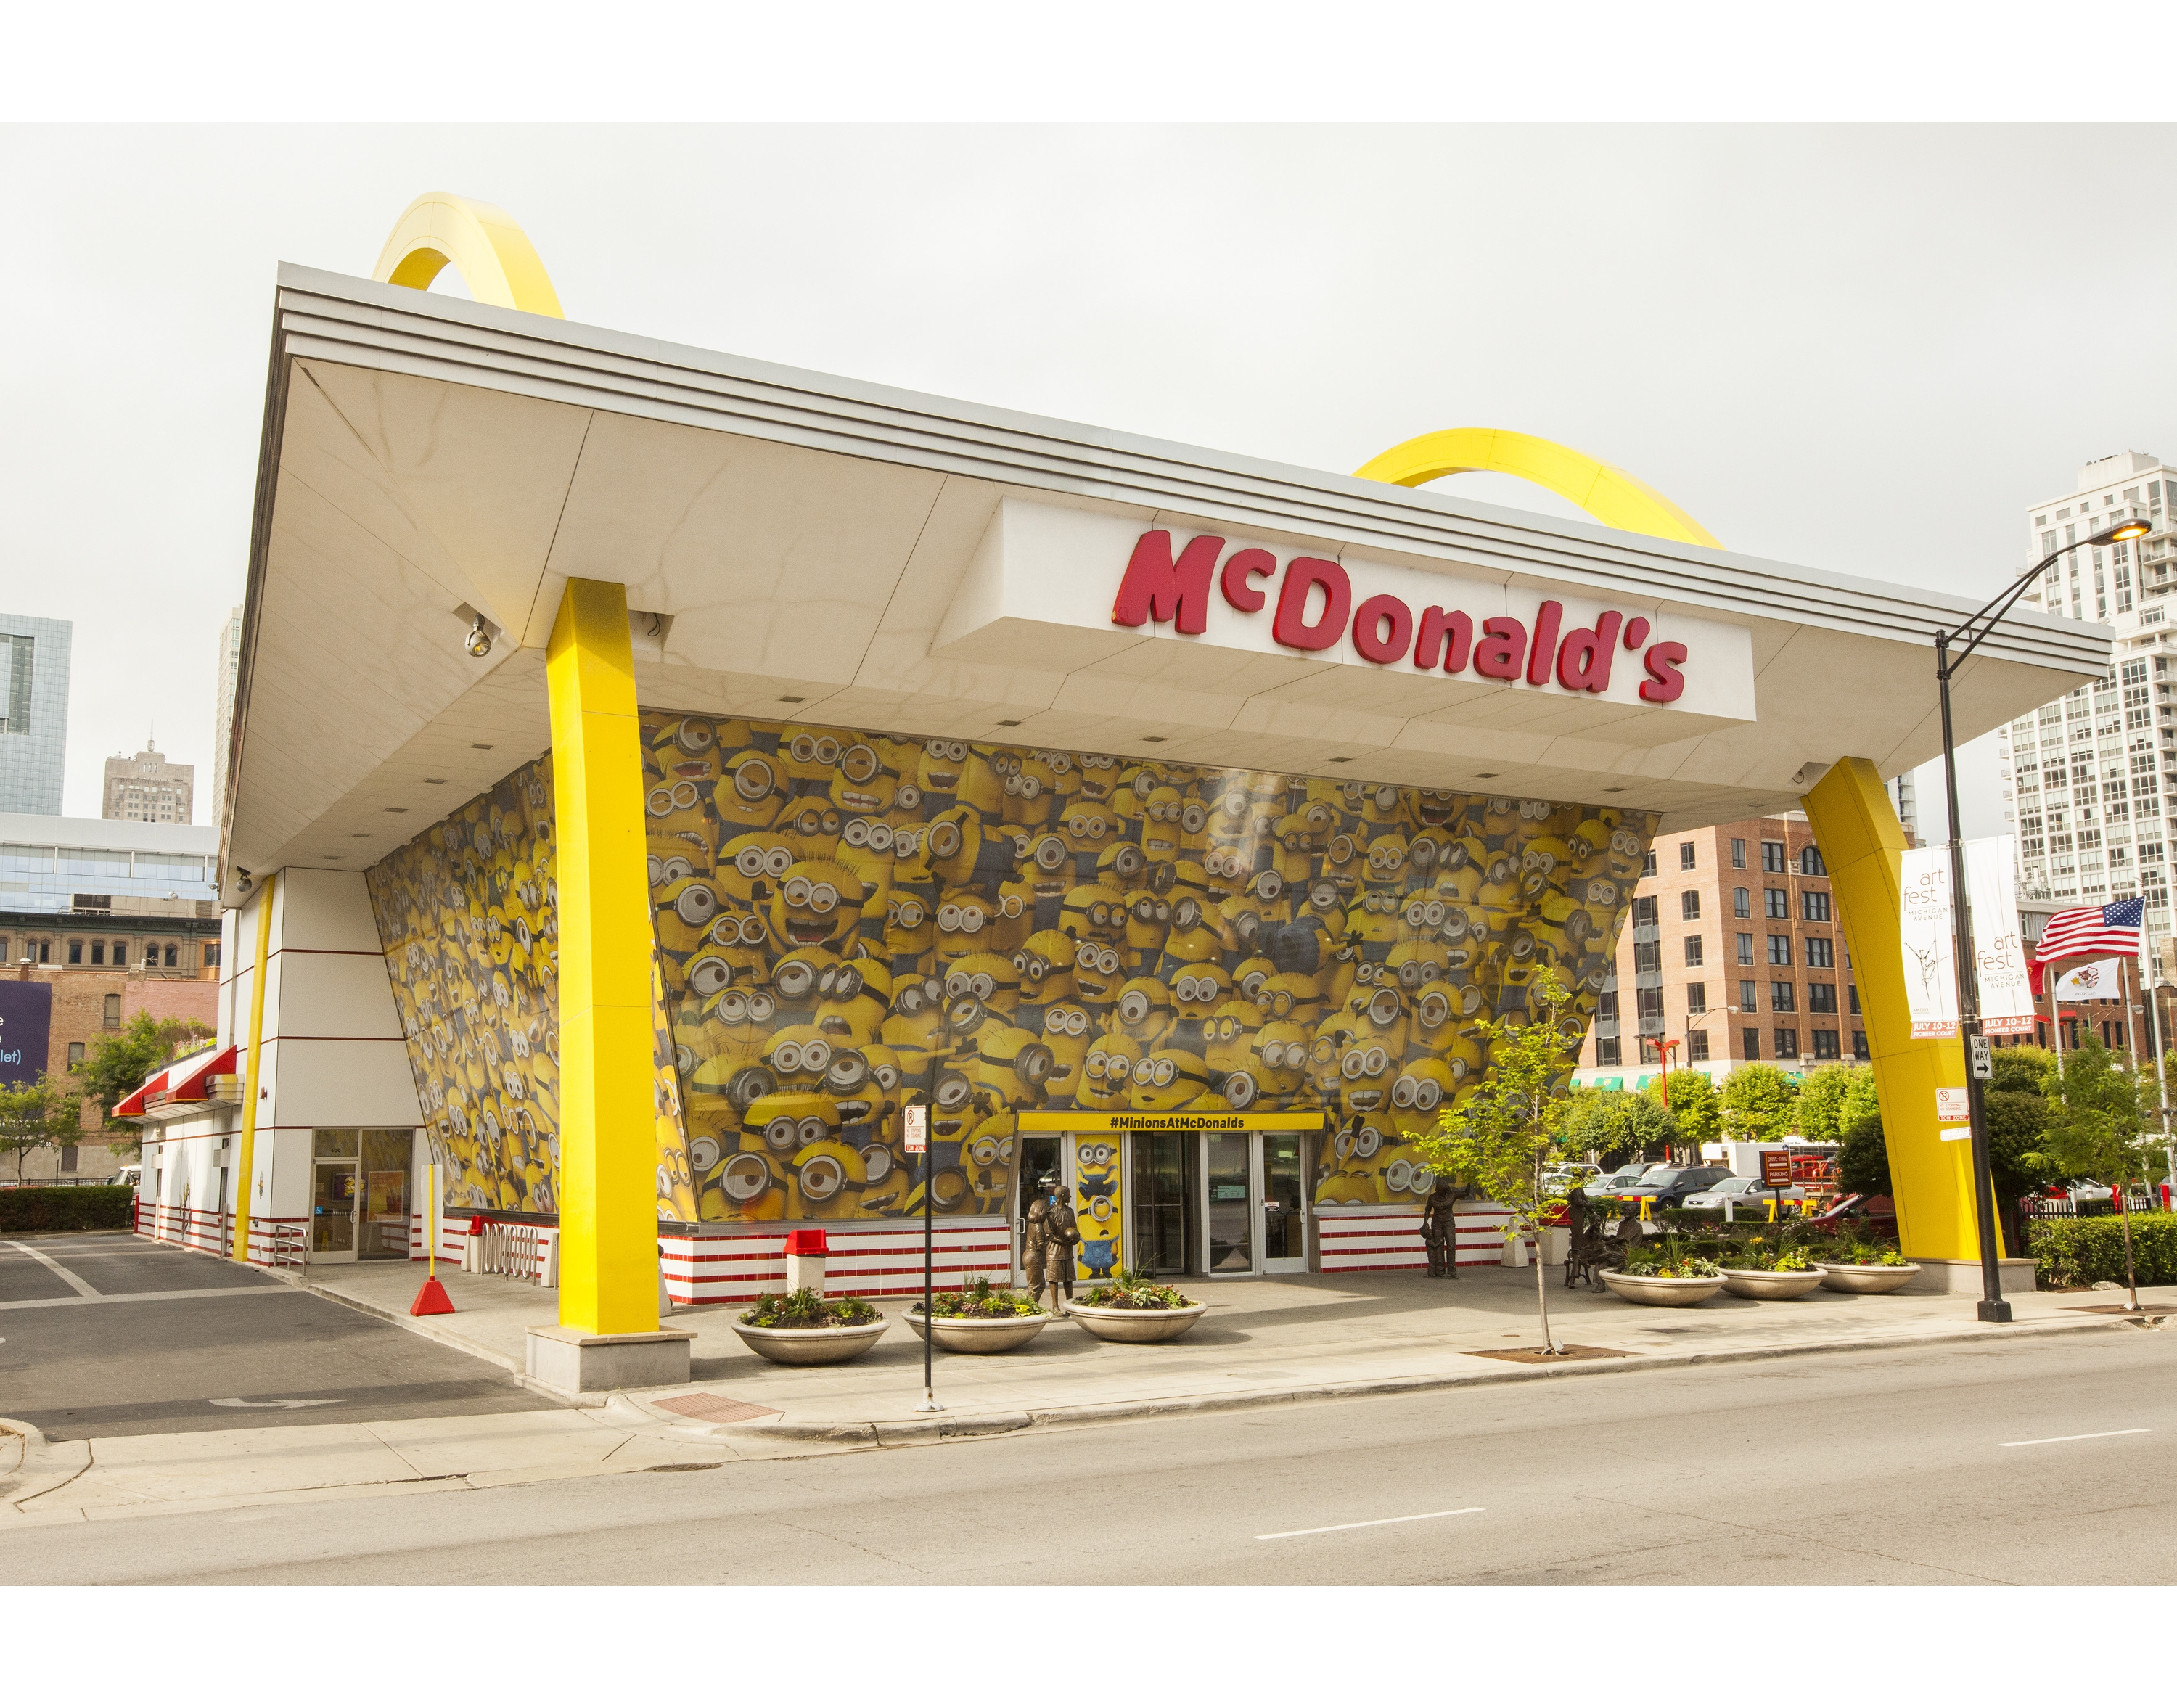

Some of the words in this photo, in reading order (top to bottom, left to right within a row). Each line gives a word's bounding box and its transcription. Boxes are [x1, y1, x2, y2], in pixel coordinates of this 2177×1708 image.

[1111, 530, 1688, 703] McDonald's
[1919, 868, 1945, 886] art
[1903, 886, 1938, 911] fest
[1908, 907, 1948, 916] MICHIGAN
[1993, 931, 2018, 951] art
[1977, 951, 2014, 978] fest
[1985, 974, 2025, 982] MICHIGAN
[1914, 1022, 1930, 1031] JULY
[1985, 1018, 2004, 1029] JULY
[2006, 1017, 2032, 1026] 10-12
[1974, 1038, 1988, 1049] ONE
[1974, 1051, 1988, 1061] WAY
[1110, 1117, 1245, 1129] #MinionsAtMcDonalds
